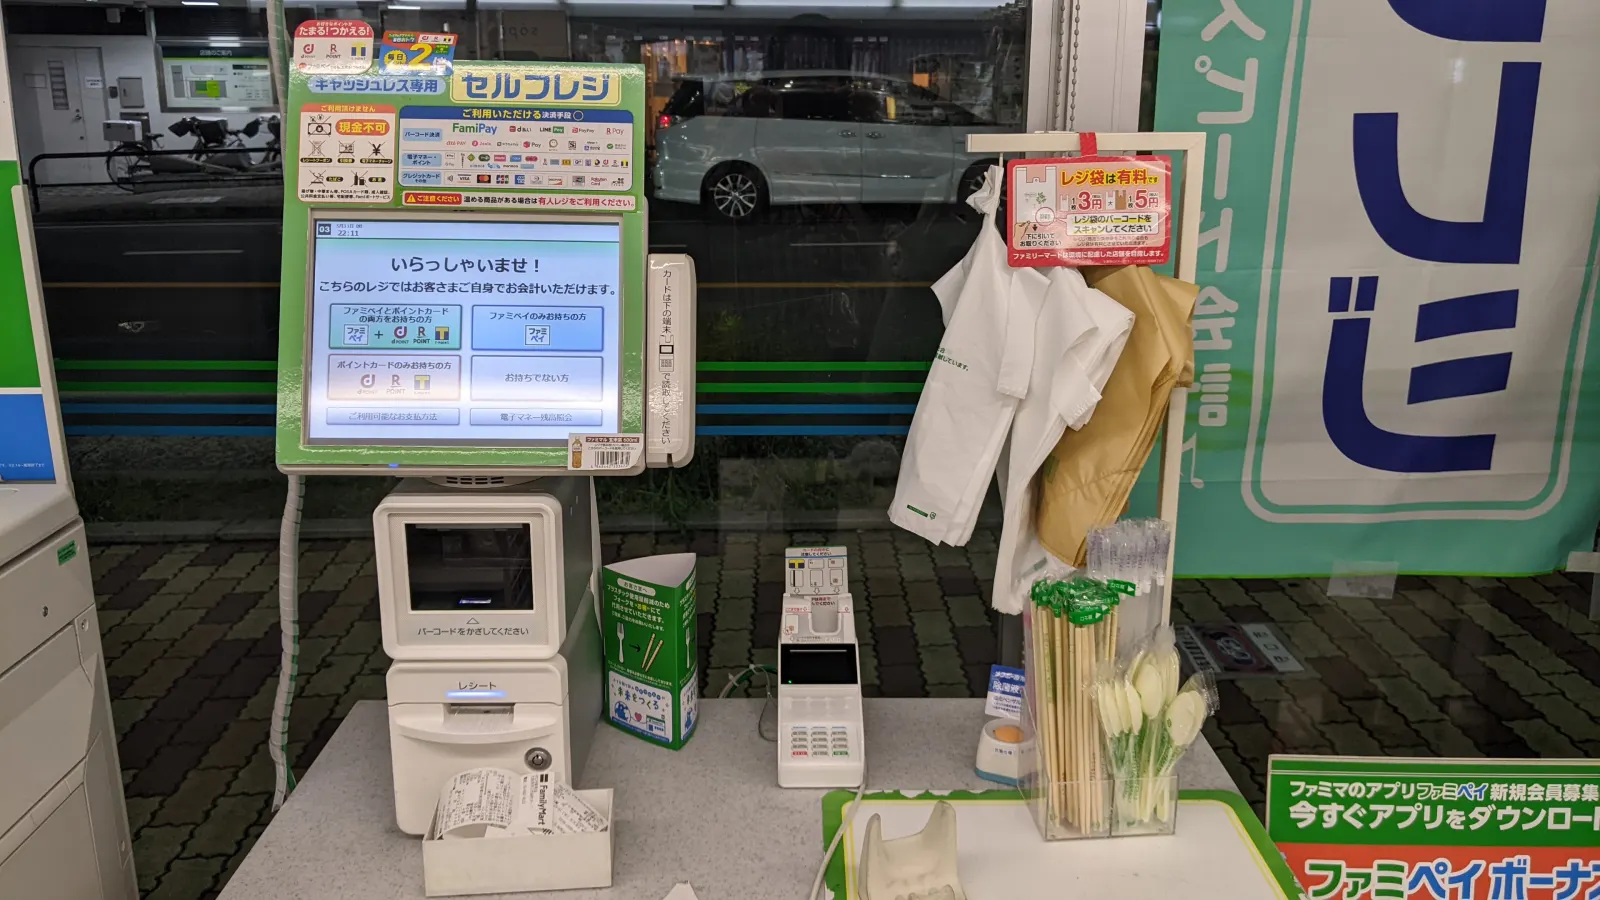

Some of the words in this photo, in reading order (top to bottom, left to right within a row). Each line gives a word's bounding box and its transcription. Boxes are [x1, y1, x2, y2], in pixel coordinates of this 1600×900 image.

[409, 43, 432, 71] 2
[315, 80, 438, 93] キャッシュレス専用
[462, 72, 610, 100] セルフレジ
[338, 122, 387, 134] 現金不可
[452, 123, 498, 135] FamiPay
[1060, 169, 1159, 186] レジ袋は有料です
[1074, 214, 1152, 224] レジ袋のバーコードを
[319, 226, 330, 234] 03
[1074, 224, 1152, 234] スキャンしてください
[392, 256, 539, 273] いらっしゃいませ!
[319, 281, 615, 296] こちらのレジではお客さまご自身でお会計いただけます。
[662, 270, 672, 334] カードは下の端末
[344, 306, 449, 315] ファミペイとポイントカード
[359, 316, 432, 324] の両方をお持ちの方
[490, 312, 586, 321] ファミペイのみお持ちの方
[348, 334, 362, 342] ペイ
[530, 335, 545, 343] ペイ
[337, 361, 452, 370] ポイントカードのみお持ちの方
[505, 374, 569, 382] お持ちでない方
[348, 412, 438, 420] ご利用可能なお支払方法
[500, 413, 572, 421] 電子マネー残高照会
[418, 627, 529, 636] バーコードをかざしてください
[458, 682, 496, 690] レシート
[538, 784, 548, 826] FamilyMart
[1490, 854, 1600, 900] ボーナ
